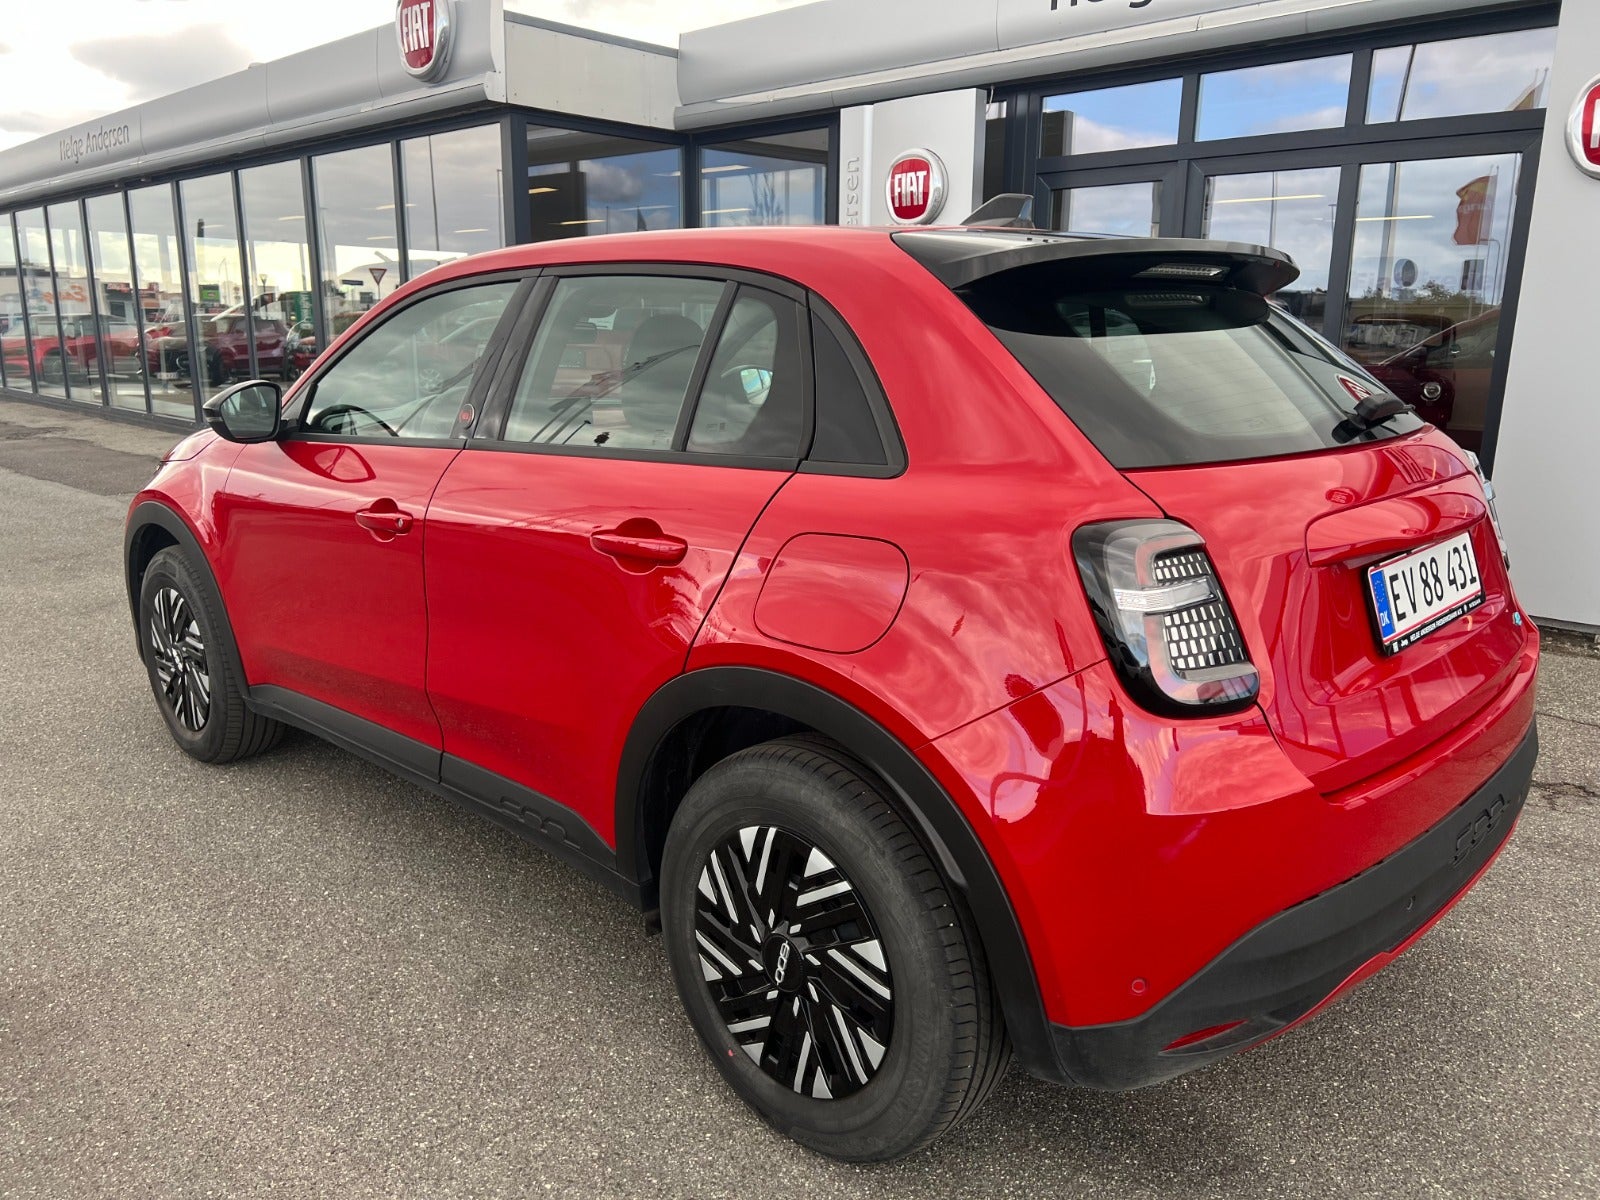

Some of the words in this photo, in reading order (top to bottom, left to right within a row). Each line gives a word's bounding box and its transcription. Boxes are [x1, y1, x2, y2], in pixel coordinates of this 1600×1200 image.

[402, 1, 431, 54] FIAT
[60, 134, 84, 165] Helge
[86, 124, 130, 154] Andersen
[894, 170, 928, 208] FIAT
[1389, 567, 1417, 622] EV
[1419, 556, 1444, 607] 88
[1447, 542, 1477, 592] 431
[1380, 612, 1390, 627] DK
[774, 940, 791, 986] 600
